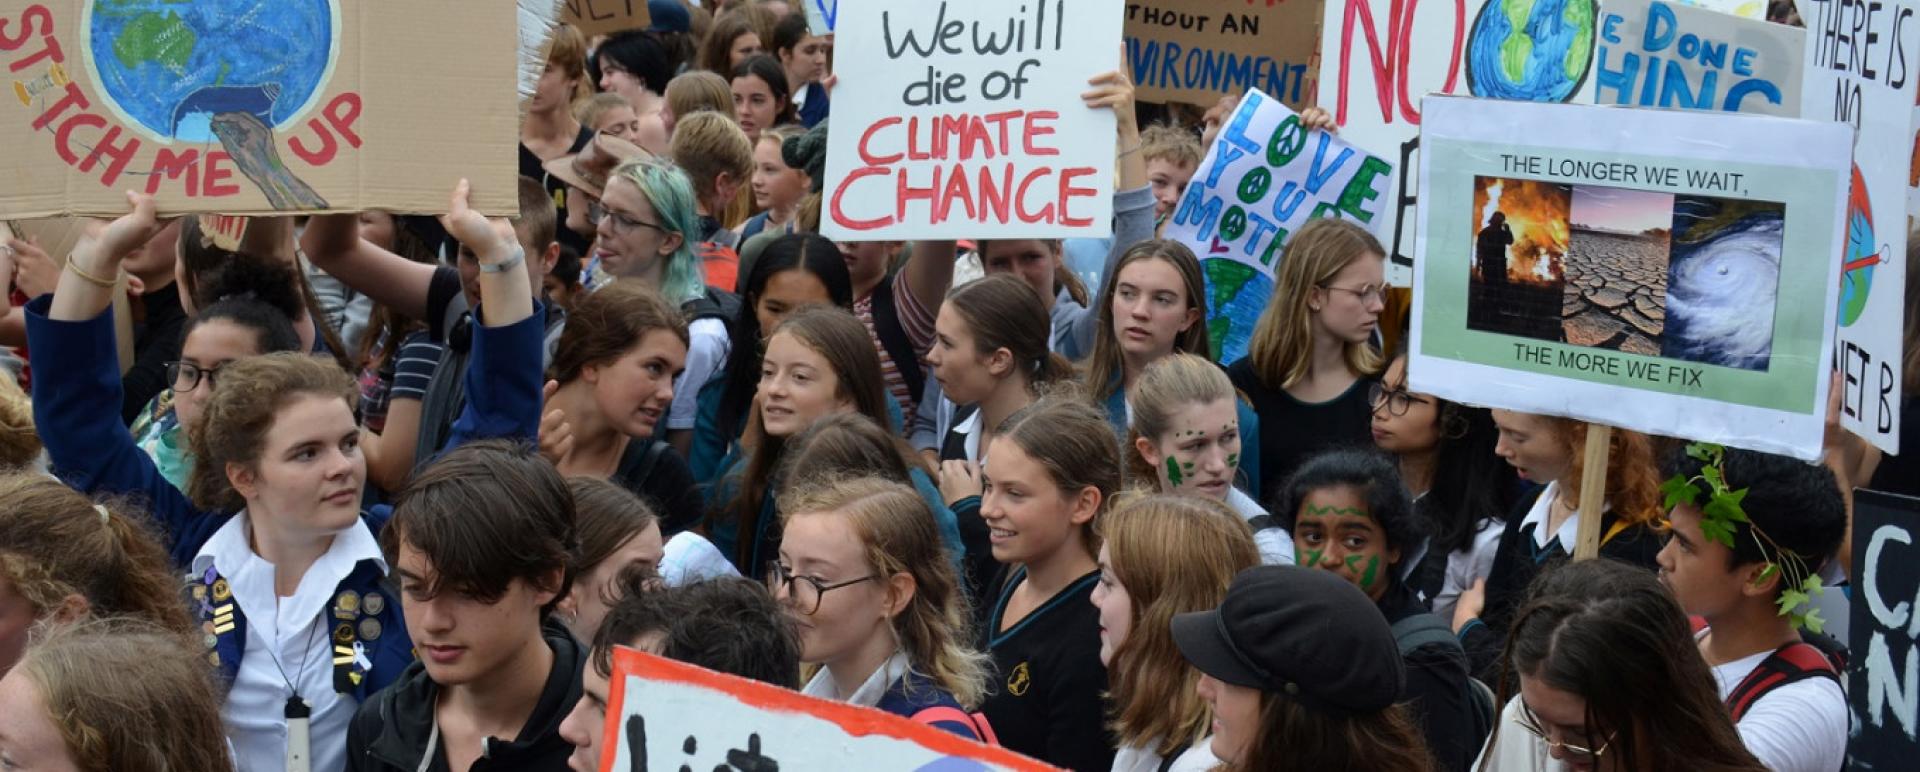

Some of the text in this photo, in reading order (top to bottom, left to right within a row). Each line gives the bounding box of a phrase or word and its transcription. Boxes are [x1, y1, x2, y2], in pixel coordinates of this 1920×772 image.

[882, 1, 964, 58] We
[972, 0, 1064, 55] will
[1125, 4, 1259, 36] THOUT AN
[1643, 3, 1758, 76] DONE
[1811, 0, 1914, 90] THERE IS
[902, 58, 1042, 106] die of
[1336, 0, 1465, 126] NO
[144, 147, 241, 198] ME
[287, 92, 364, 167] UP
[857, 109, 1061, 166] CLIMATE
[1224, 91, 1393, 224] LOVE
[829, 162, 1098, 231] CHANGE
[1501, 154, 1749, 196] THE LONGER WE WAIT,
[1513, 342, 1704, 388] THE MORE WE FIX
[1877, 361, 1894, 434] B
